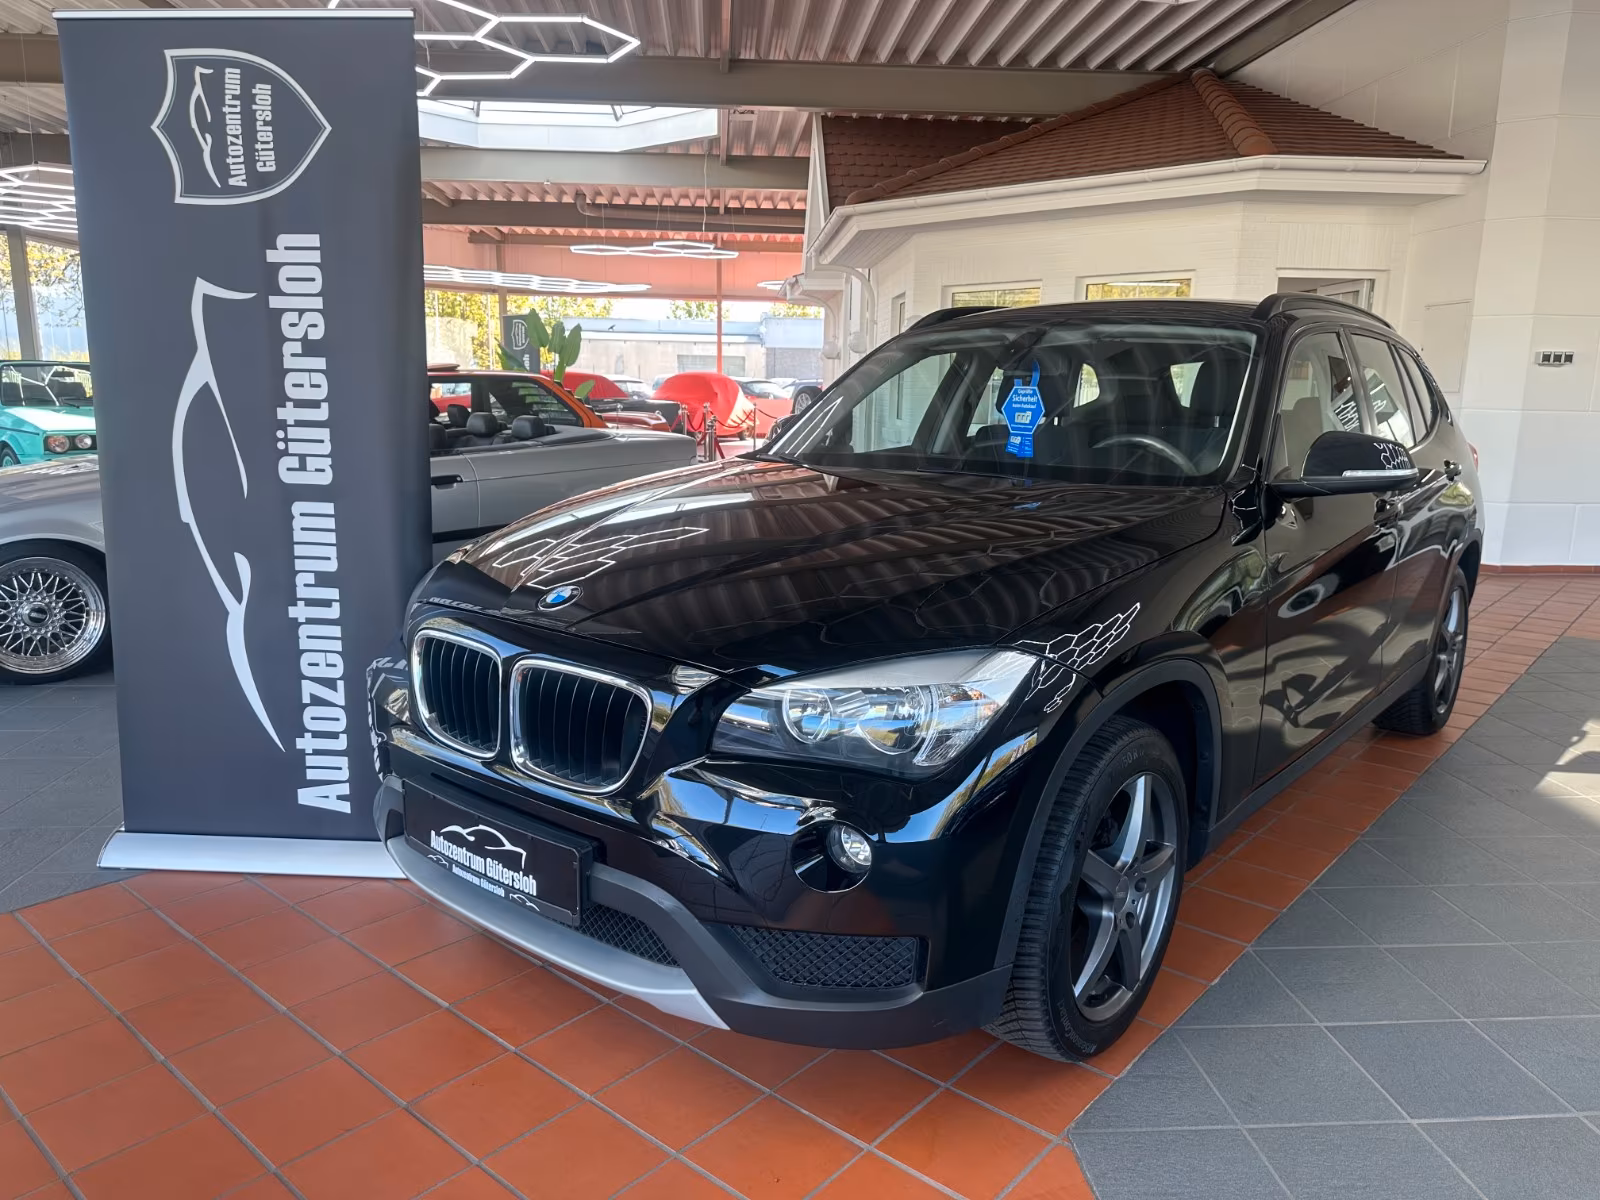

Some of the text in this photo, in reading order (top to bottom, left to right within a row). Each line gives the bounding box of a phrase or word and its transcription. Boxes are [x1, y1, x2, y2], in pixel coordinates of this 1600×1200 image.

[222, 67, 248, 187] Autozentrum
[251, 83, 276, 172] Gütersloh
[1012, 394, 1037, 402] Sicherheit
[266, 233, 351, 814] Autozentrum Gütersloh
[430, 830, 537, 896] Autozentrum Gütersloh
[452, 863, 505, 898] Autozentrum Gütersloh
